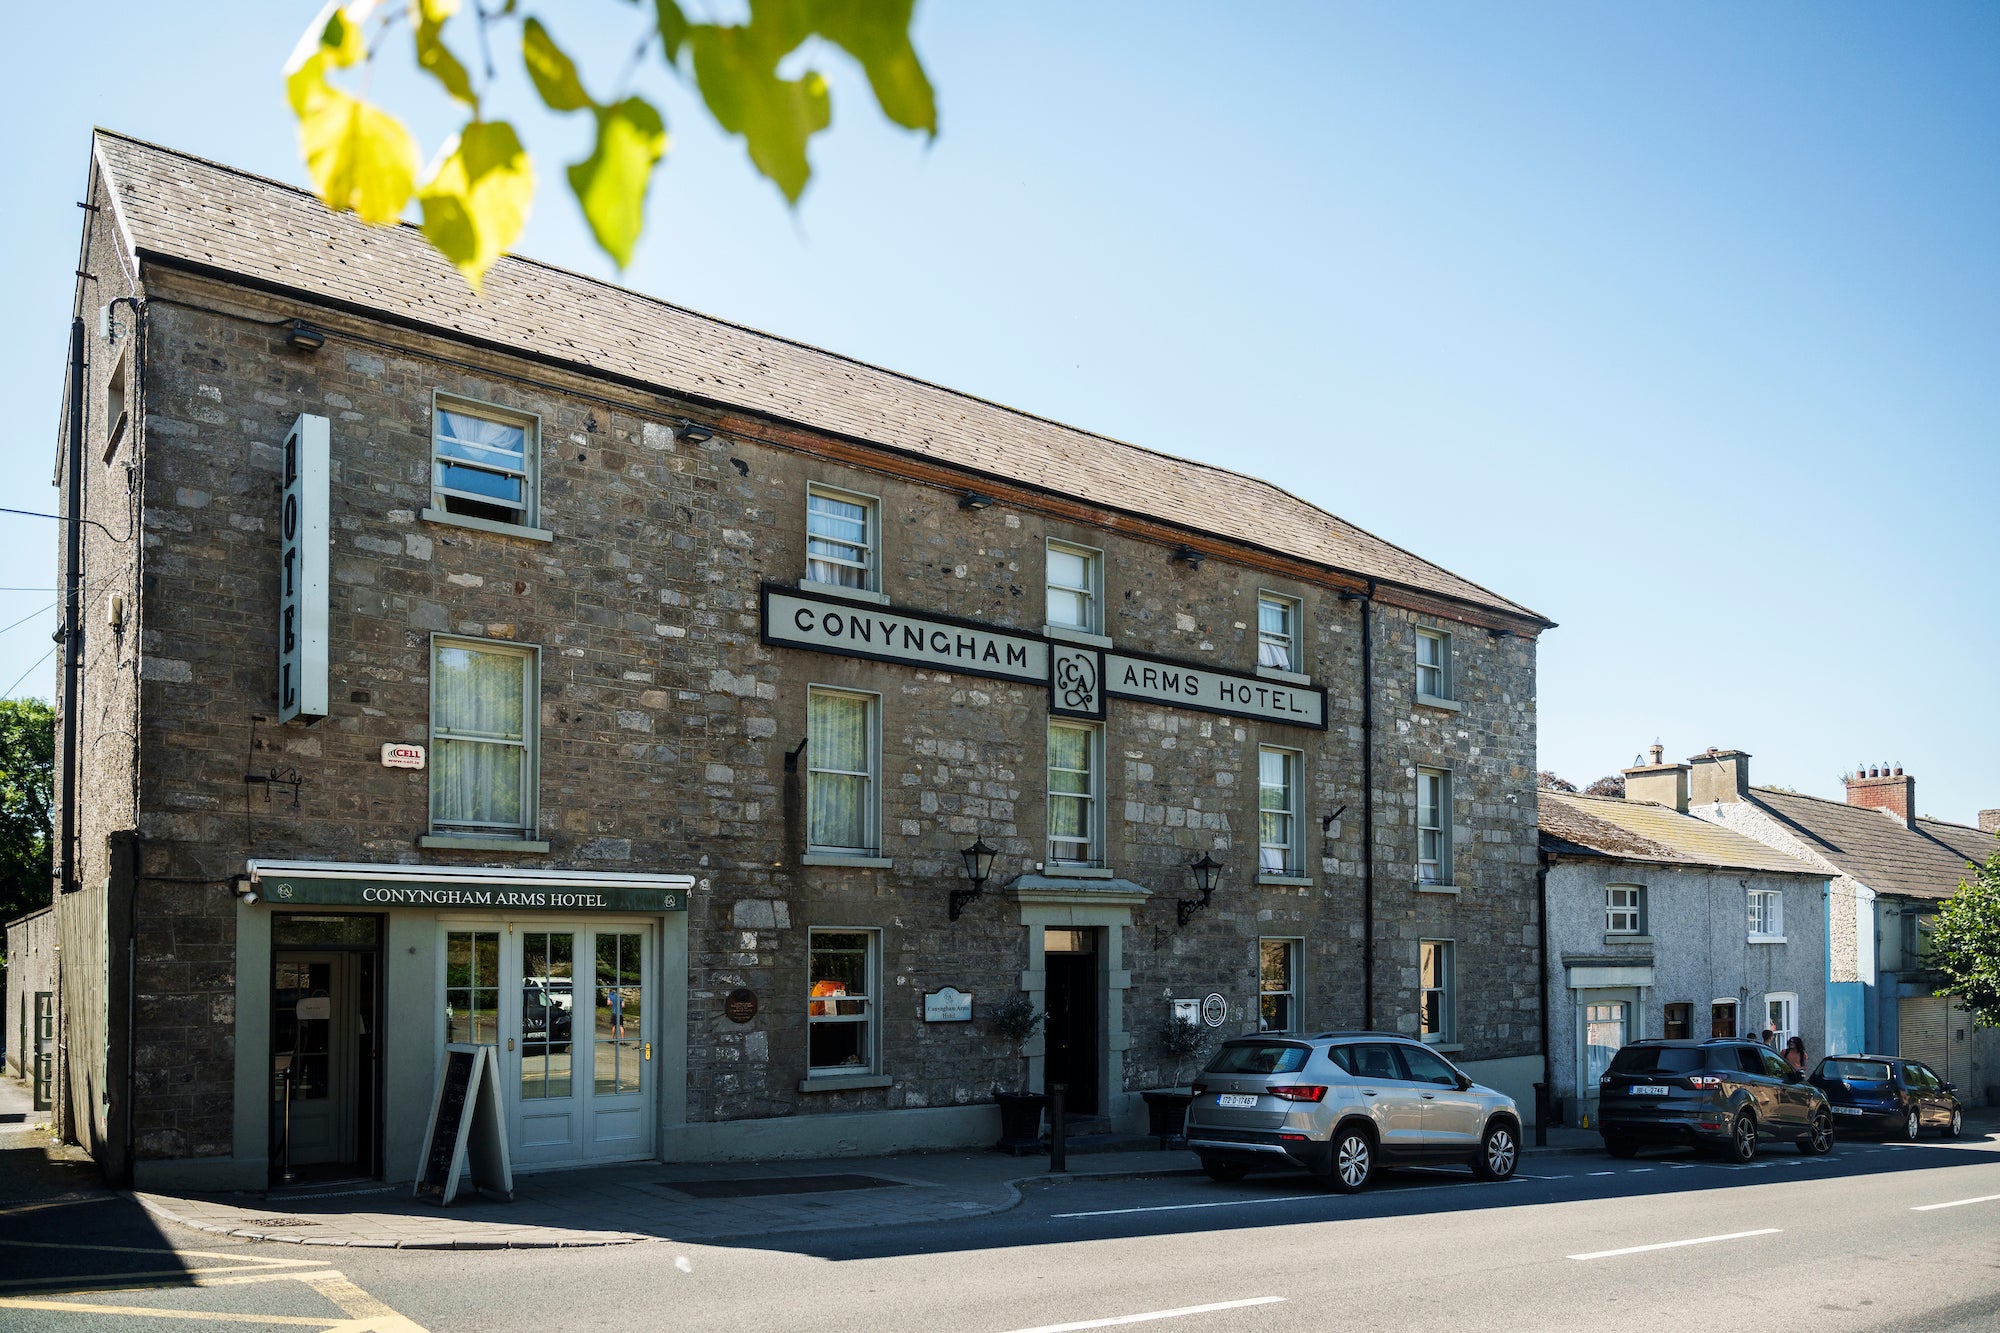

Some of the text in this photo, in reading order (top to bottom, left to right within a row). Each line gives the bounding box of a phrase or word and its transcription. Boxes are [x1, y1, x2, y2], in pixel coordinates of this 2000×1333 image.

[282, 433, 298, 710] HOTEL
[794, 607, 1309, 715] CONYNGHAM ARMS HOTEL.
[396, 749, 421, 759] CELL
[362, 886, 607, 908] CONYNGHAM ARMS HOTEL
